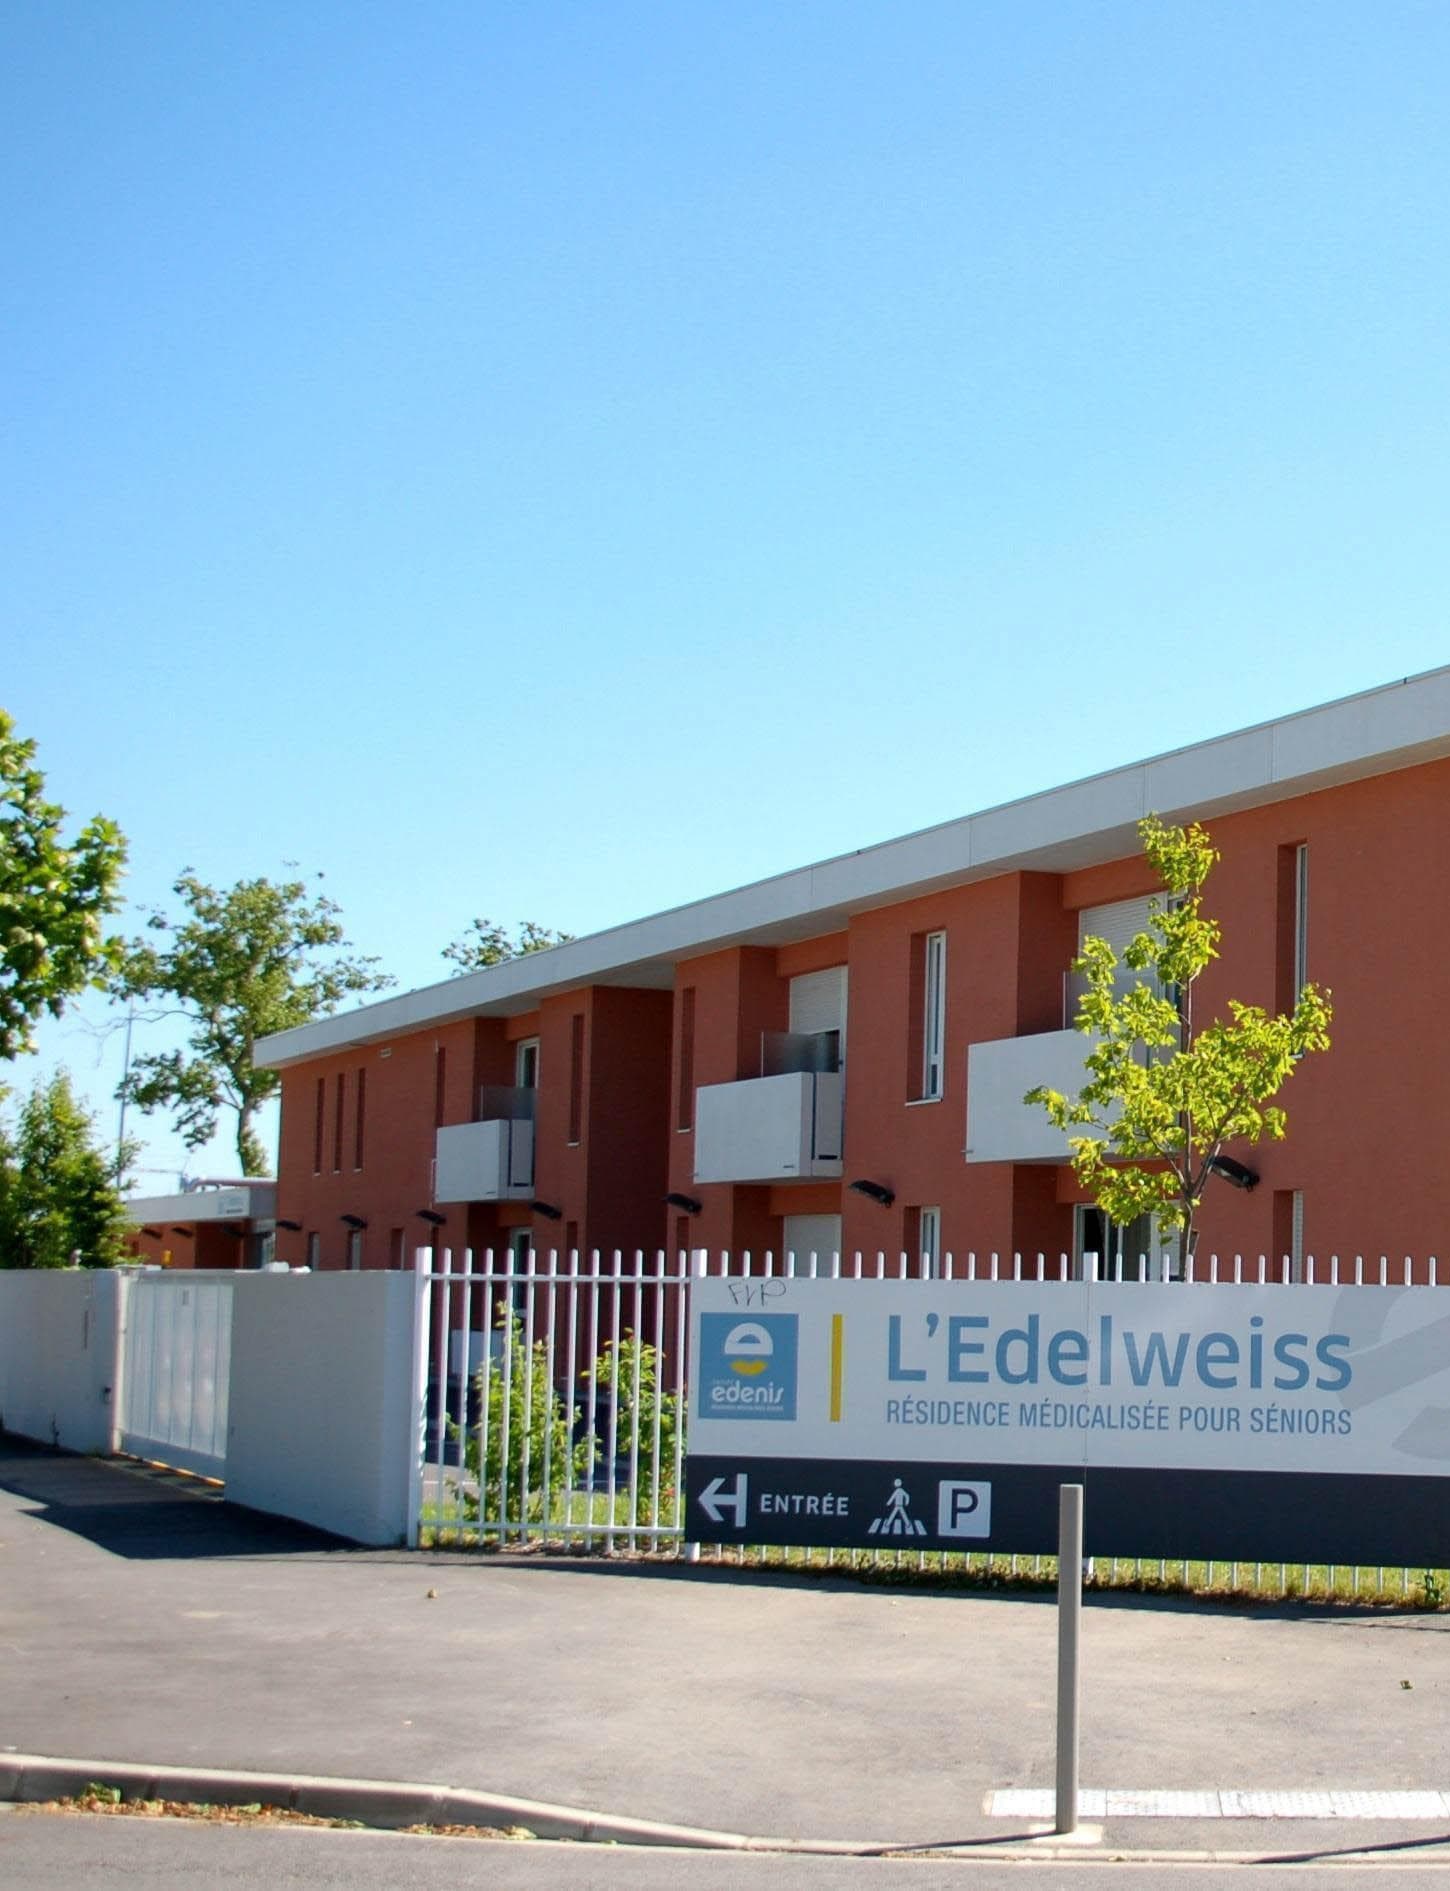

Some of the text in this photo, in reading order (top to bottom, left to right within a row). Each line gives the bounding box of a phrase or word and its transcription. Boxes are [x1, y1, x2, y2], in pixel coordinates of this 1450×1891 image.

[888, 1313, 1353, 1391] L'Edelweiss
[711, 1380, 784, 1404] edenis
[887, 1394, 1352, 1435] RÉSIDENCE MÉDICALISÉE POUR SÉNIORS
[759, 1487, 980, 1530] ENTRÉE P
